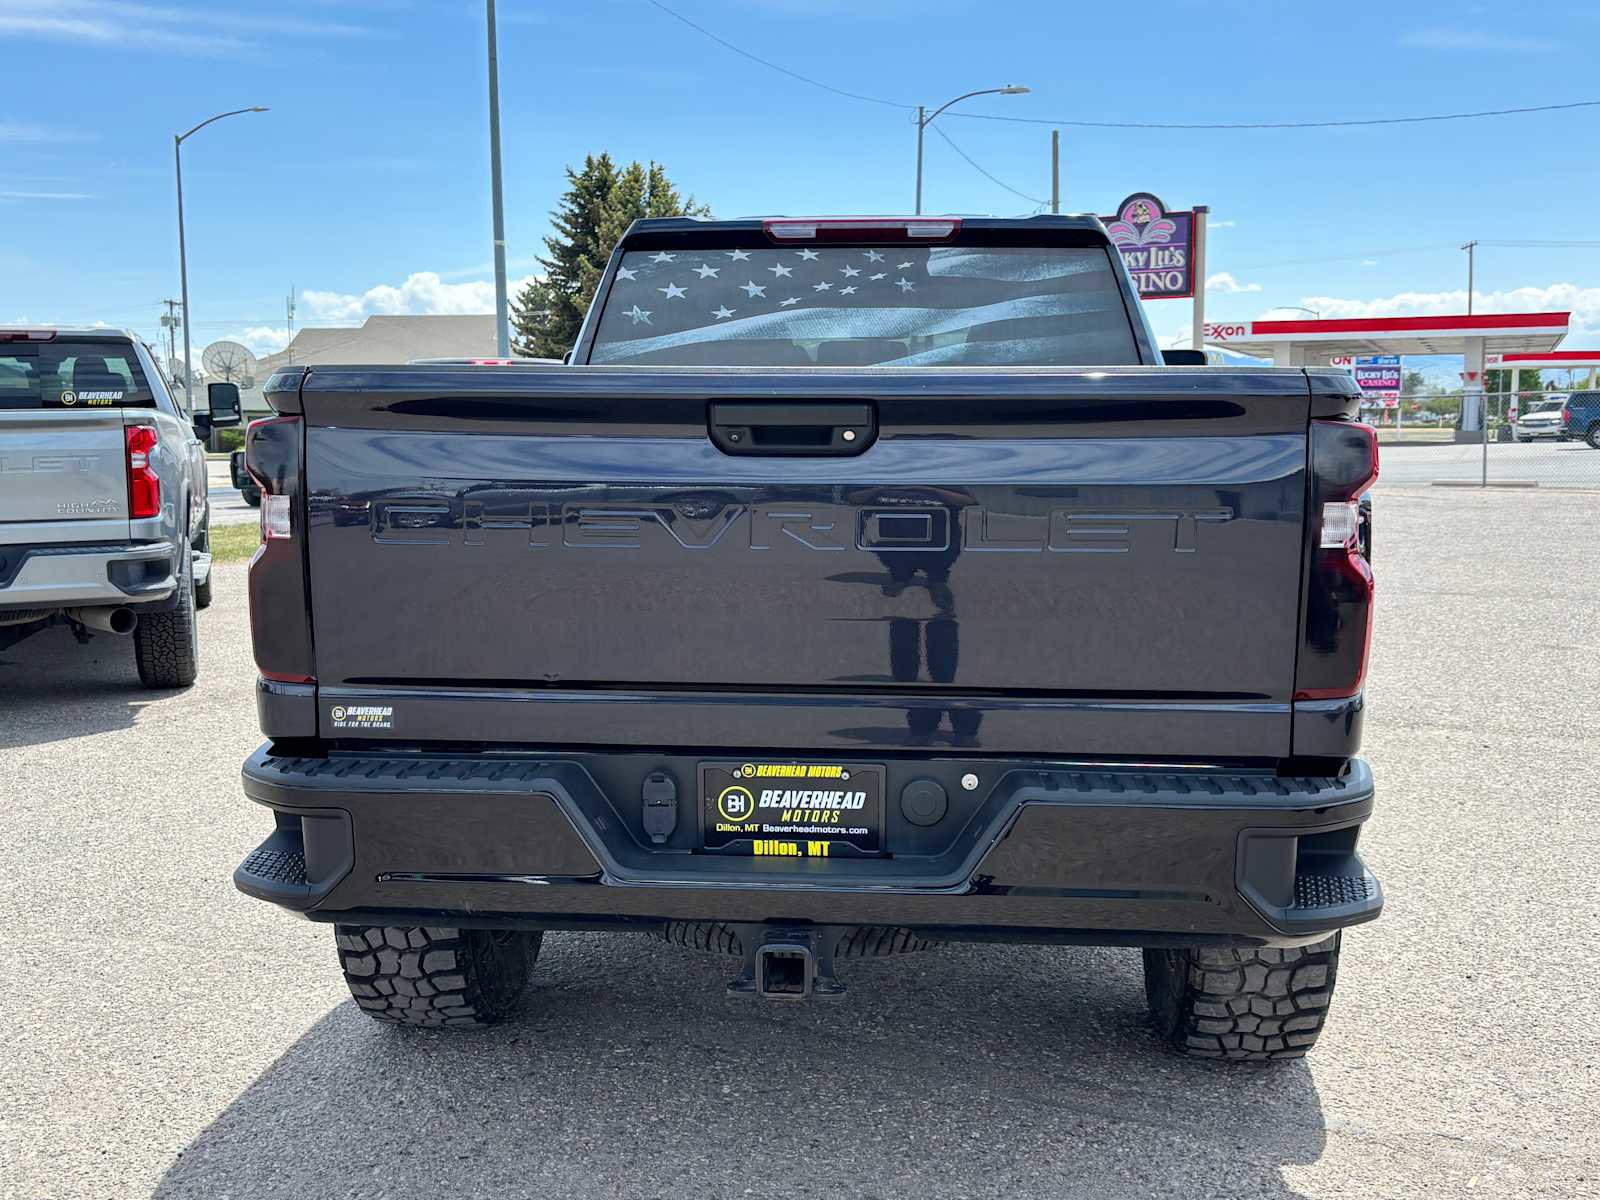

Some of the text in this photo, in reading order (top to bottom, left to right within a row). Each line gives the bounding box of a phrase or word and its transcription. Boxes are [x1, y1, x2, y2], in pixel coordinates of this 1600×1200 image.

[79, 391, 123, 400] BEAVERHEAD
[372, 500, 1235, 552] CHEVROLET
[347, 707, 393, 716] BEAVERHEAD
[756, 765, 807, 777] BEAVERHEAD
[807, 766, 843, 778] MOTORS
[758, 790, 866, 810] BEAVERHEAD
[781, 809, 841, 823] MOTORS
[716, 824, 868, 835] Dillon, MT Beaverheadmotors.com
[753, 840, 830, 857] Dillon, MT
